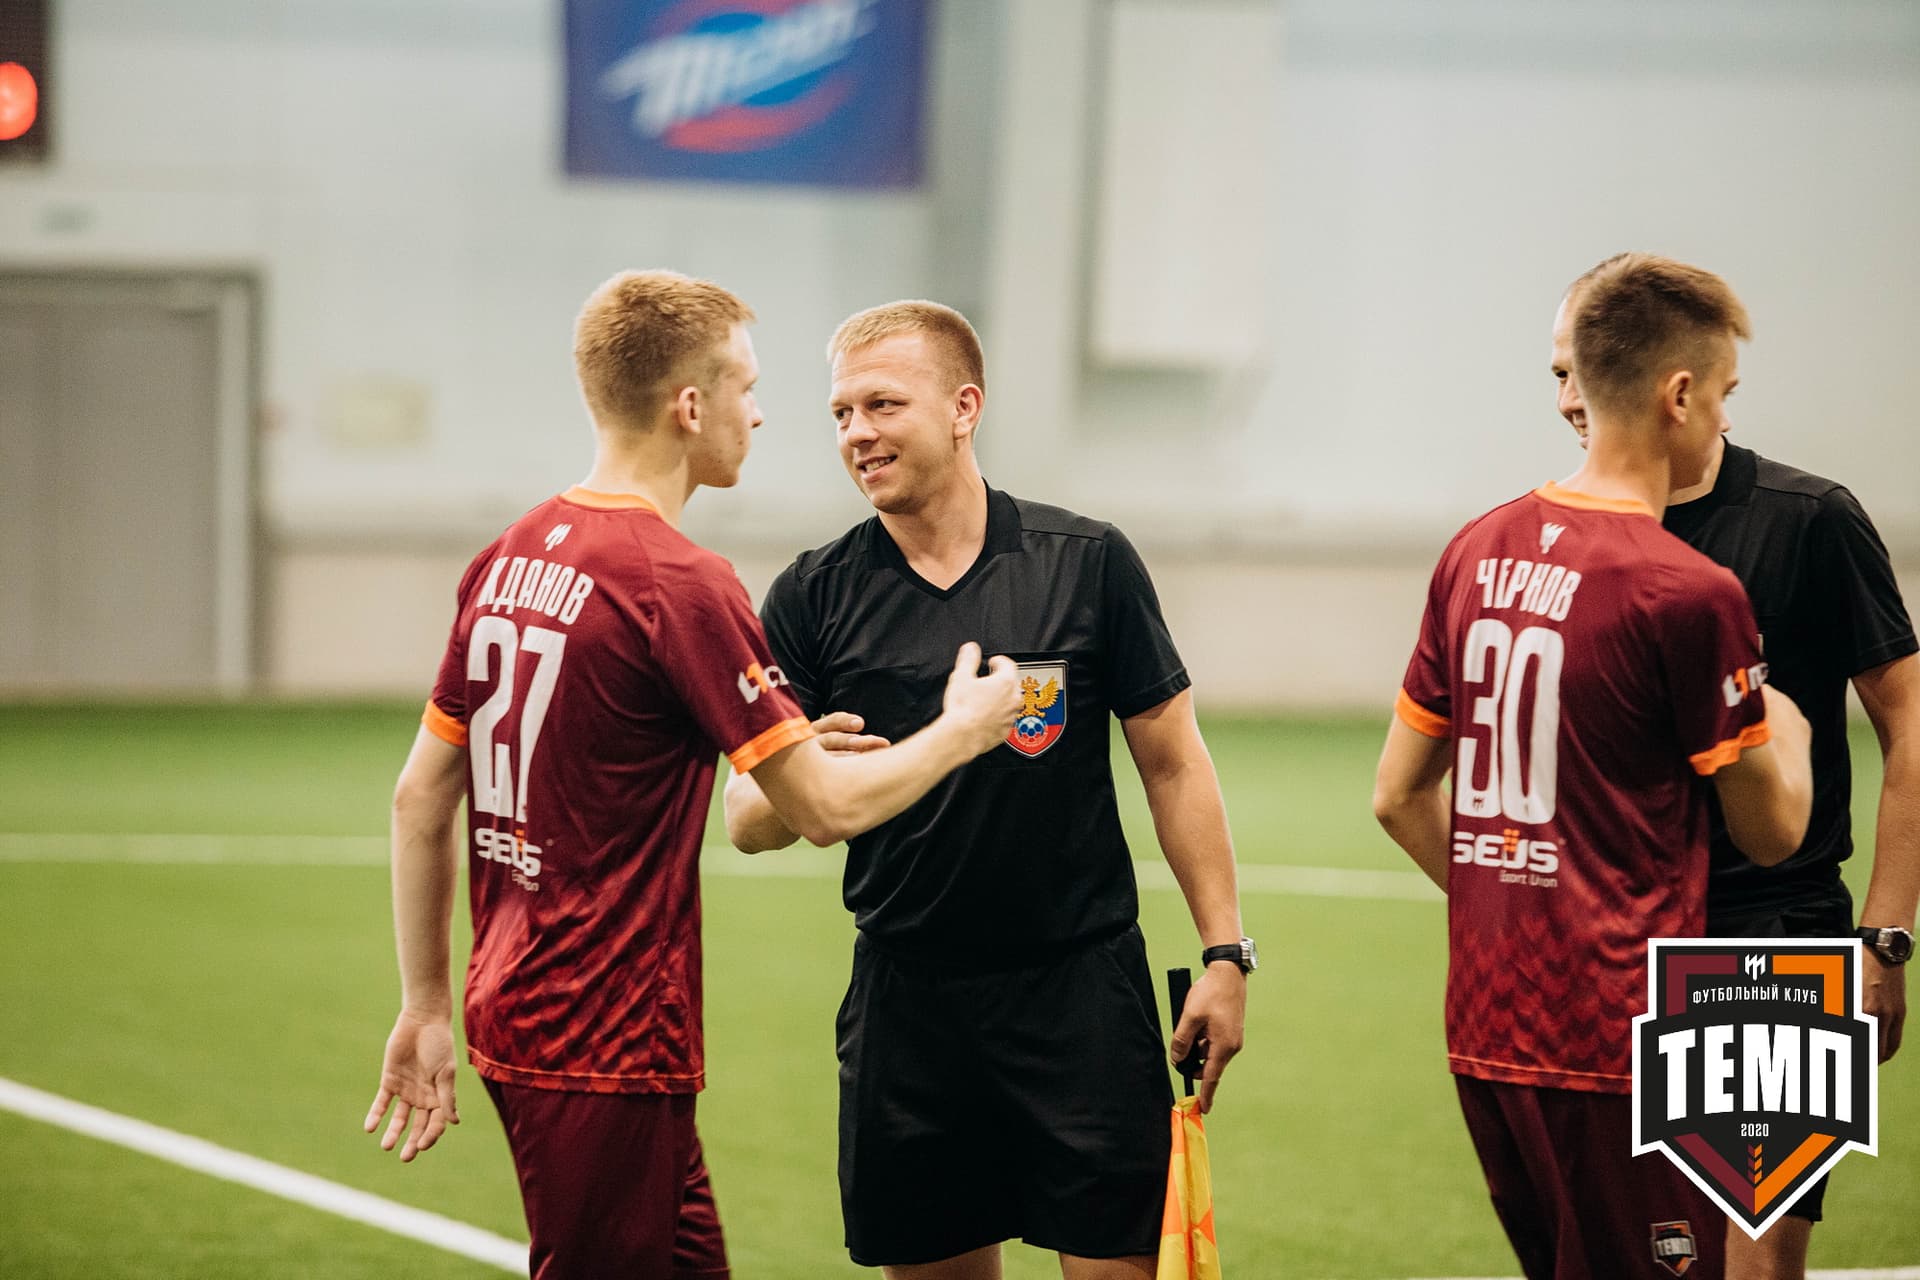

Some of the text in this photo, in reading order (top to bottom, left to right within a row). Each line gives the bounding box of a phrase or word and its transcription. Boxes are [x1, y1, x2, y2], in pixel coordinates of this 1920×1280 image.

[1475, 558, 1582, 622] ЧЕРНОВ
[467, 615, 568, 824] 27
[1455, 618, 1565, 824] 30
